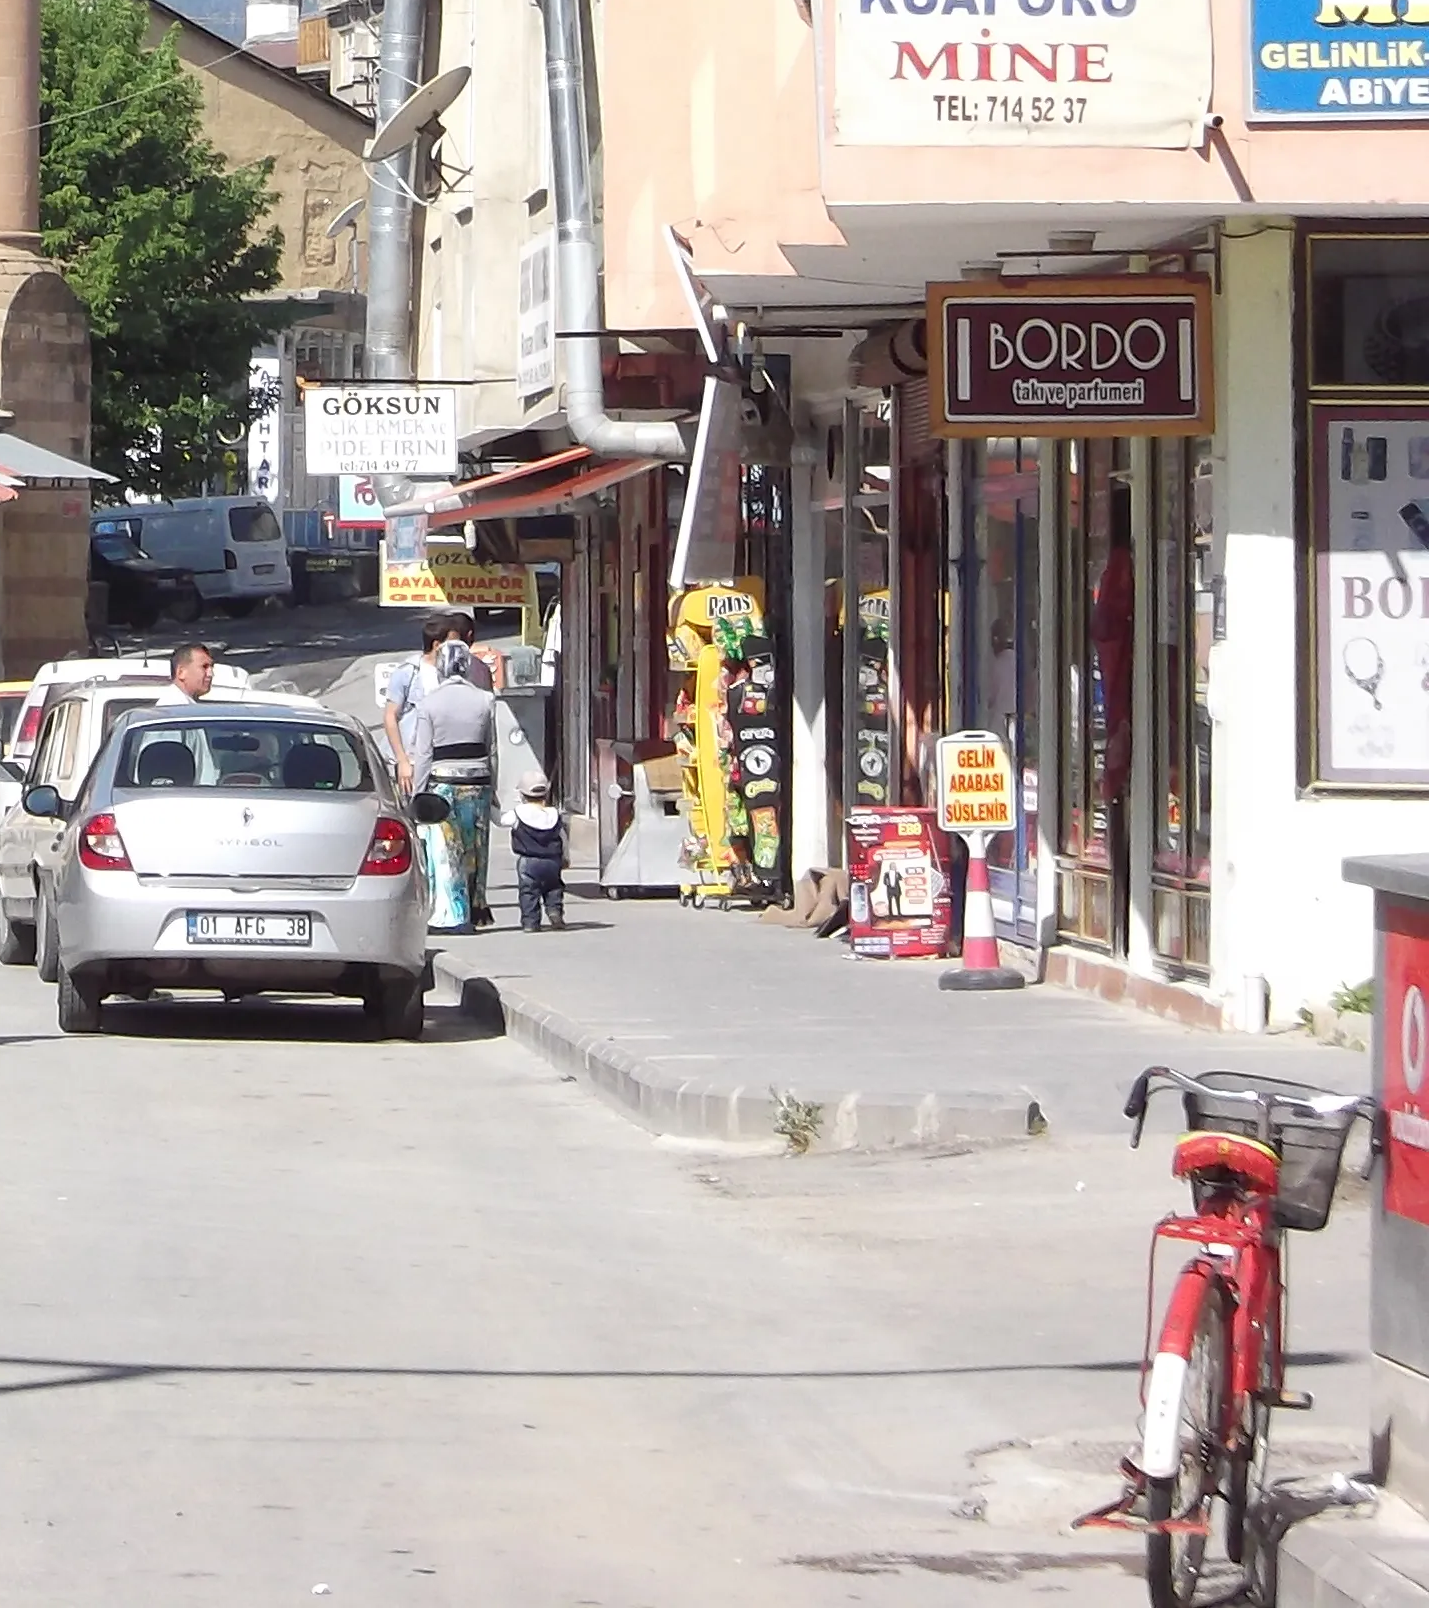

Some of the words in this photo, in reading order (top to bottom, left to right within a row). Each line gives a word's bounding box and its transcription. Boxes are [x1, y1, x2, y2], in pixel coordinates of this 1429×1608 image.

[890, 28, 1113, 83] MİNE
[933, 95, 979, 122] TEL:
[987, 95, 1024, 123] 714
[1031, 96, 1056, 123] 52
[1063, 97, 1088, 125] 37
[990, 317, 1167, 371] BORDO
[323, 392, 441, 415] GÖKSUN
[1047, 383, 1064, 403] ve
[389, 577, 445, 589] BAYAN
[451, 576, 523, 589] KUAFÖR
[957, 744, 995, 768] GELİN
[949, 773, 1004, 793] ARABASI
[946, 797, 1008, 822] SÜSLENİR
[200, 916, 217, 936] 01
[234, 916, 266, 936] AFG
[286, 917, 307, 937] 38
